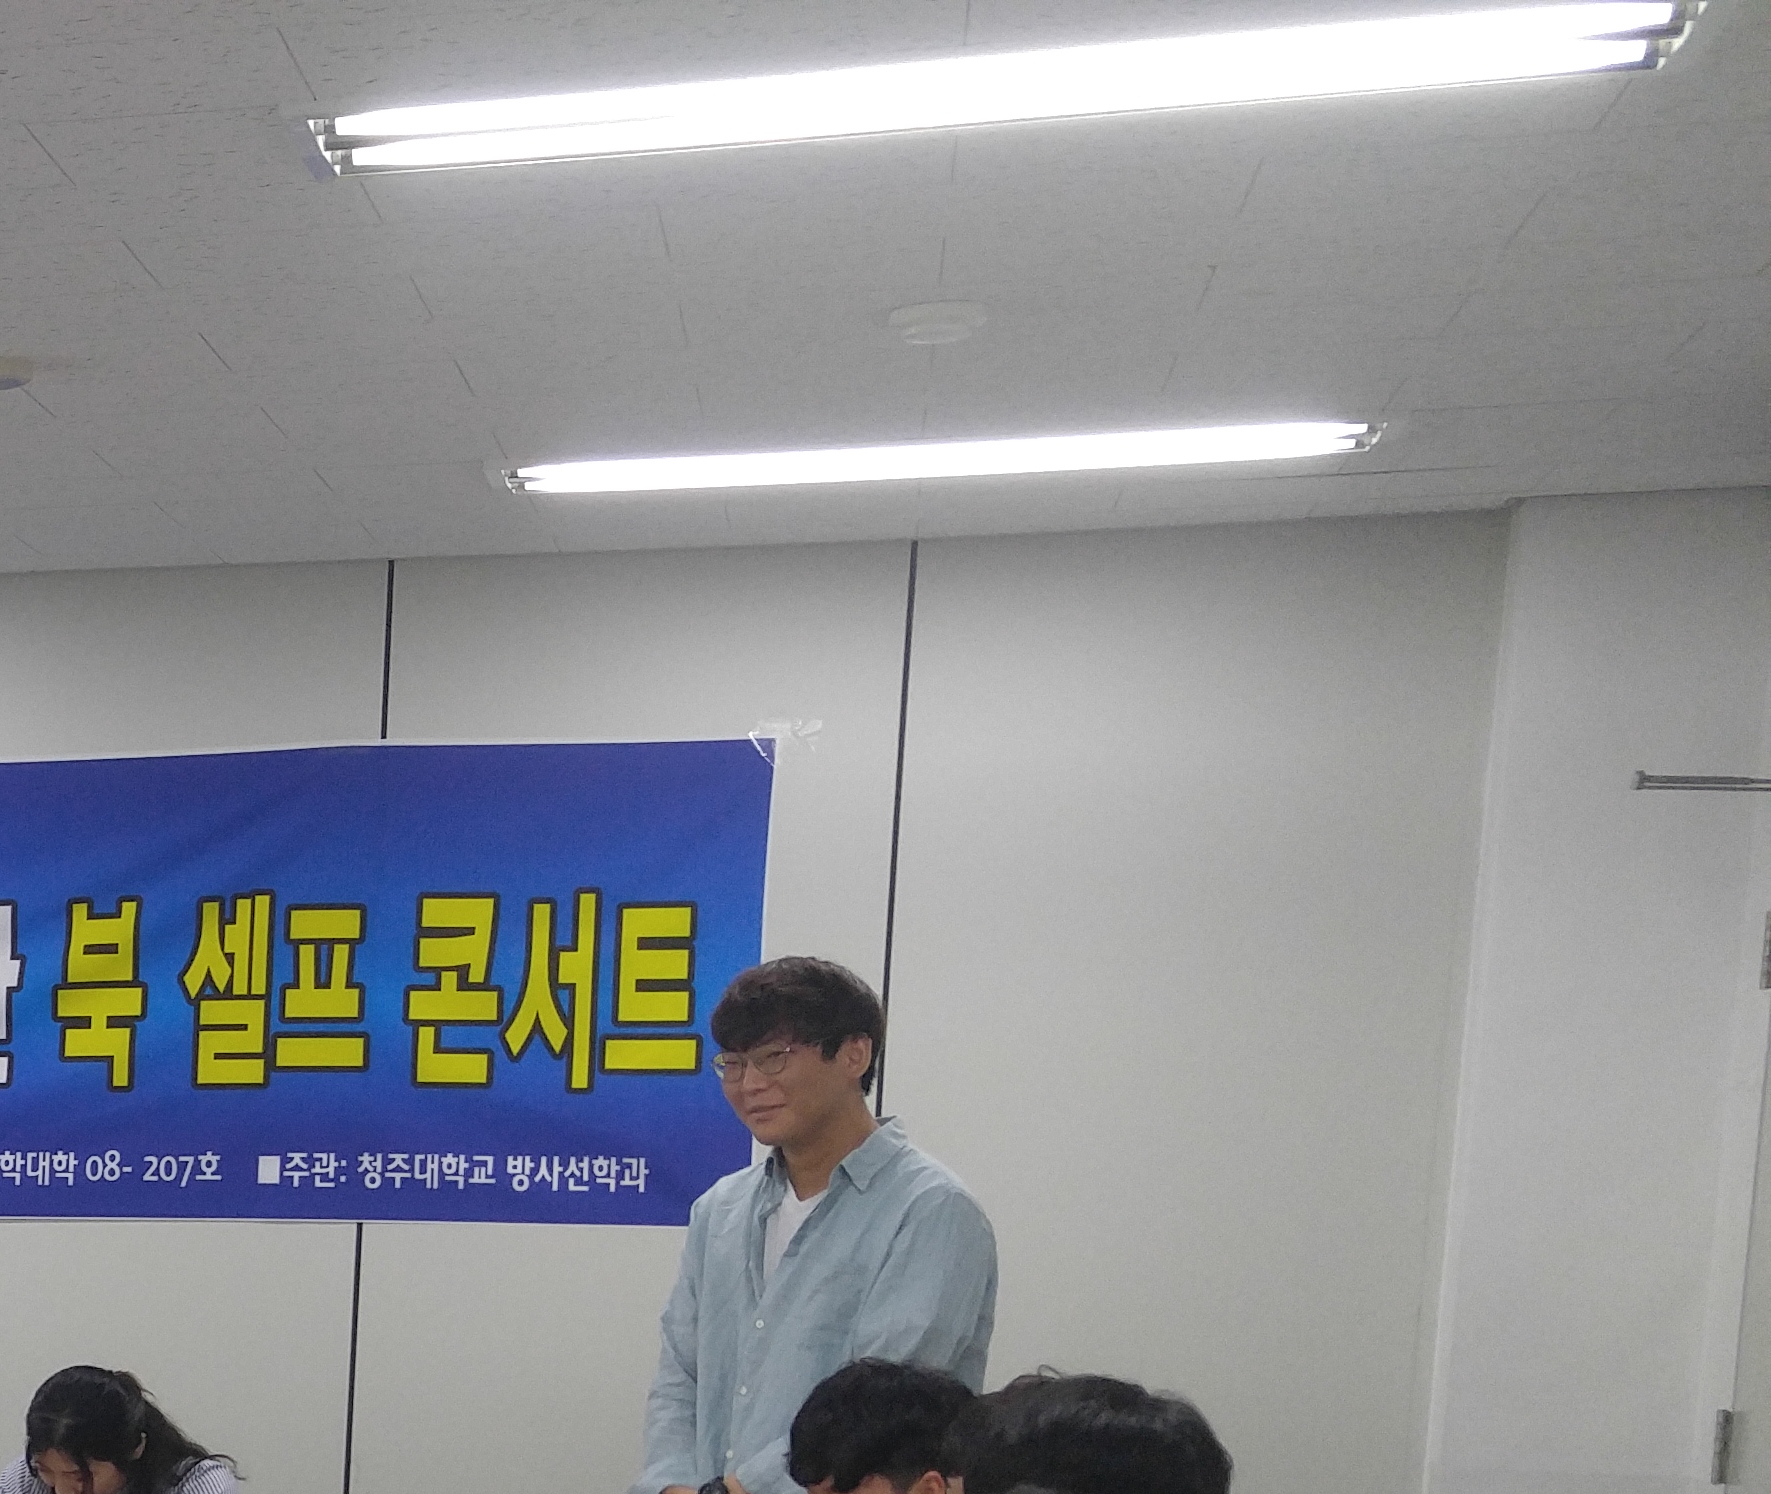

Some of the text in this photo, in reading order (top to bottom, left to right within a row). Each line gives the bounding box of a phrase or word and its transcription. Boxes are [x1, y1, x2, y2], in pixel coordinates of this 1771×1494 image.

[55, 899, 146, 1088] 북
[182, 893, 366, 1086] 셀프
[406, 891, 699, 1090] 콘서트
[142, 1151, 222, 1187] 207호
[357, 1152, 496, 1190] 청주대학교
[506, 1155, 649, 1193] 방사선학과
